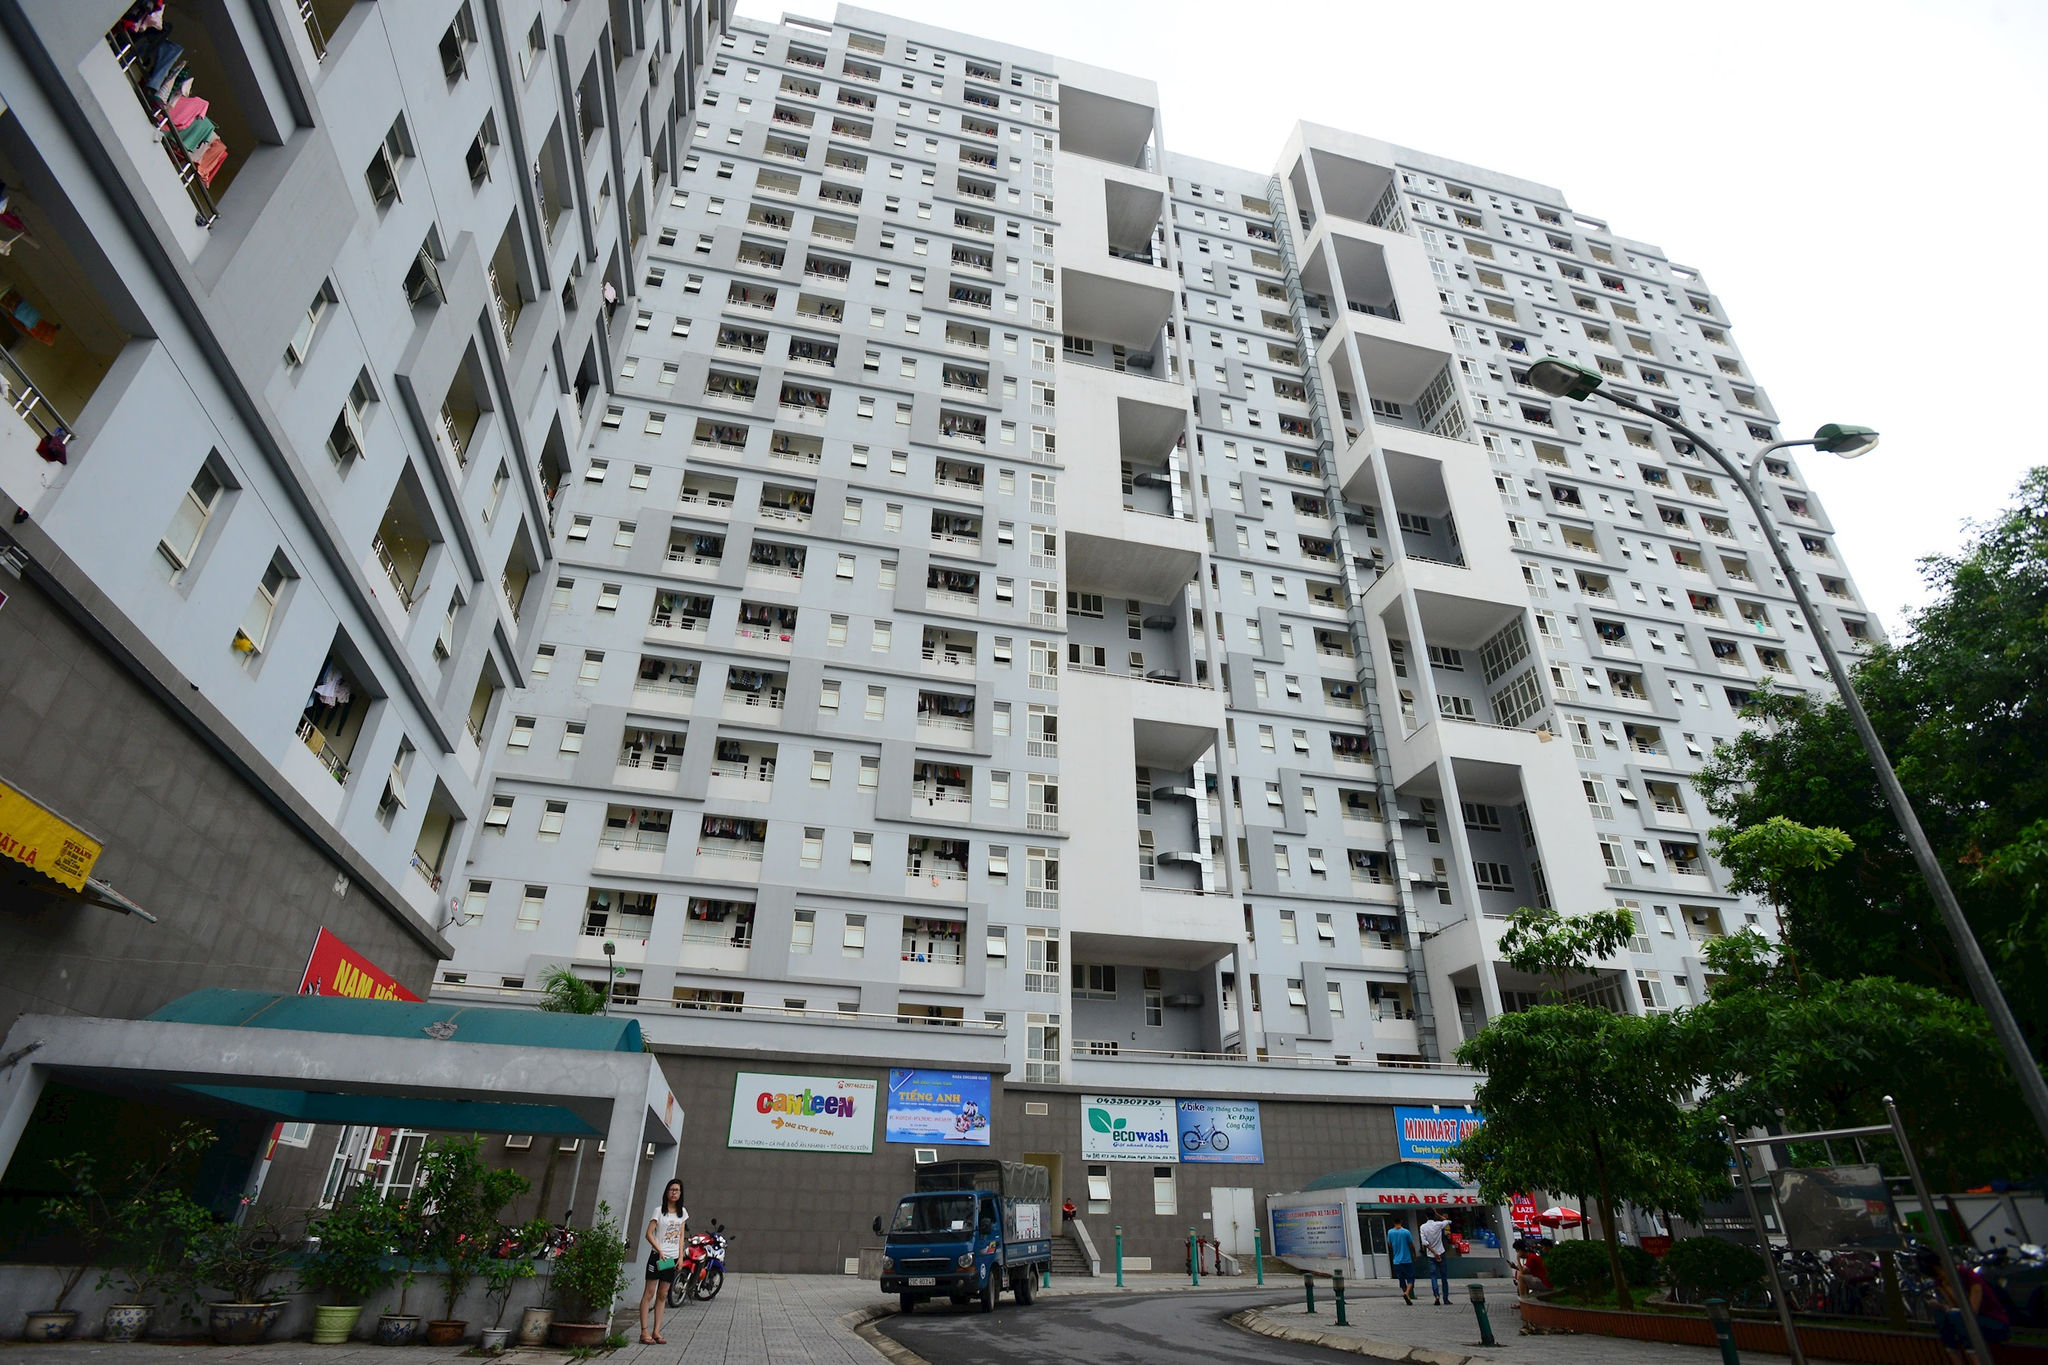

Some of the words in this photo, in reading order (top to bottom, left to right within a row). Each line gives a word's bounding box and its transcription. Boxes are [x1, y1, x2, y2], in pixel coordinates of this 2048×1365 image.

[17, 846, 37, 865] LÀ
[332, 958, 374, 999] NAM
[898, 1089, 933, 1102] TIẾNG
[936, 1094, 961, 1103] ANH
[1404, 1118, 1457, 1142] MINIMART
[1378, 1193, 1420, 1204] NHÀ
[1424, 1192, 1449, 1204] ĐỂ
[1453, 1195, 1477, 1204] XE
